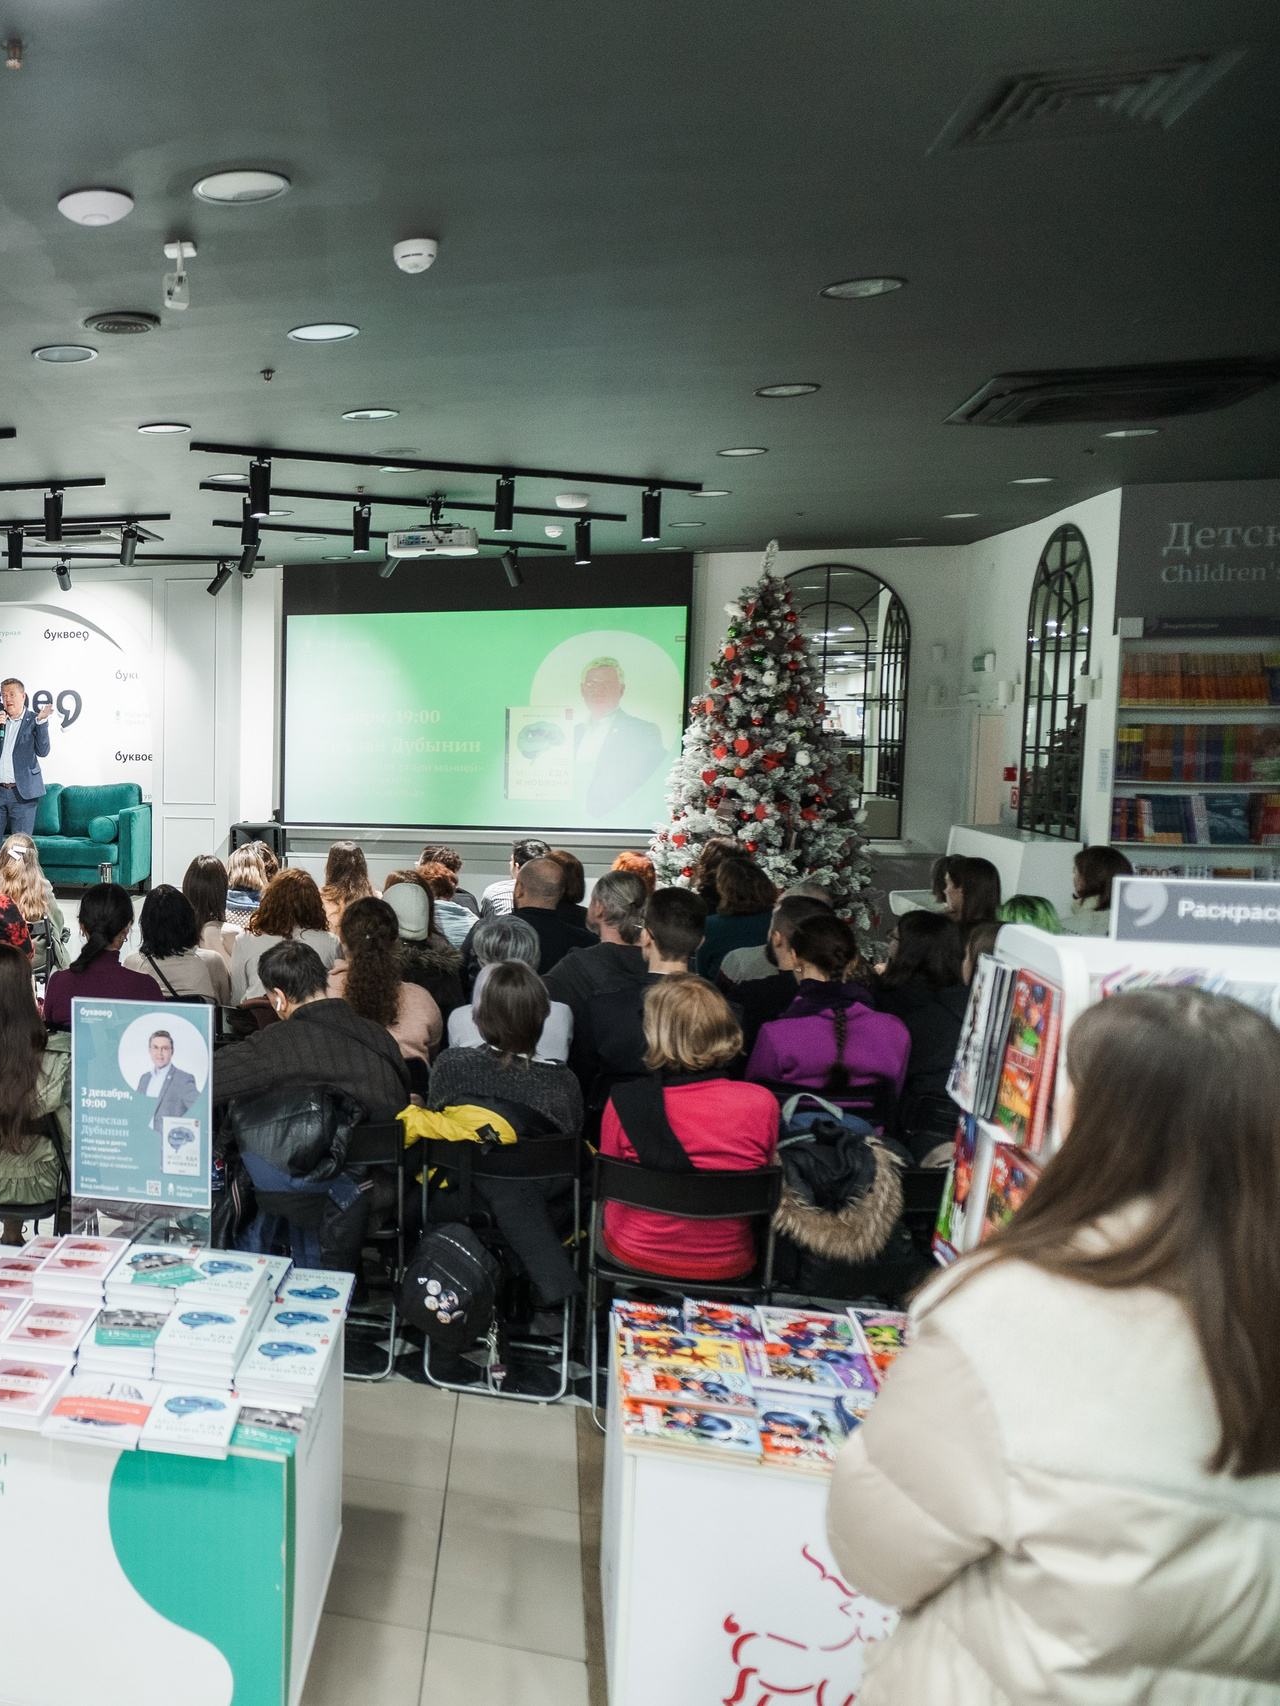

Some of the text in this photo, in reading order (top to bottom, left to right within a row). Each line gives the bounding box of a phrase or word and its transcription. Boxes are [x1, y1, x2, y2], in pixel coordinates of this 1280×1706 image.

[44, 628, 89, 641] буквоед
[395, 709, 441, 724] 19:00
[391, 737, 482, 755] Дубынин
[81, 1087, 133, 1101] 3 декабря,
[81, 1099, 107, 1109] 19:00
[81, 1114, 129, 1126] Вячеслав
[81, 1125, 129, 1137] Дубынин
